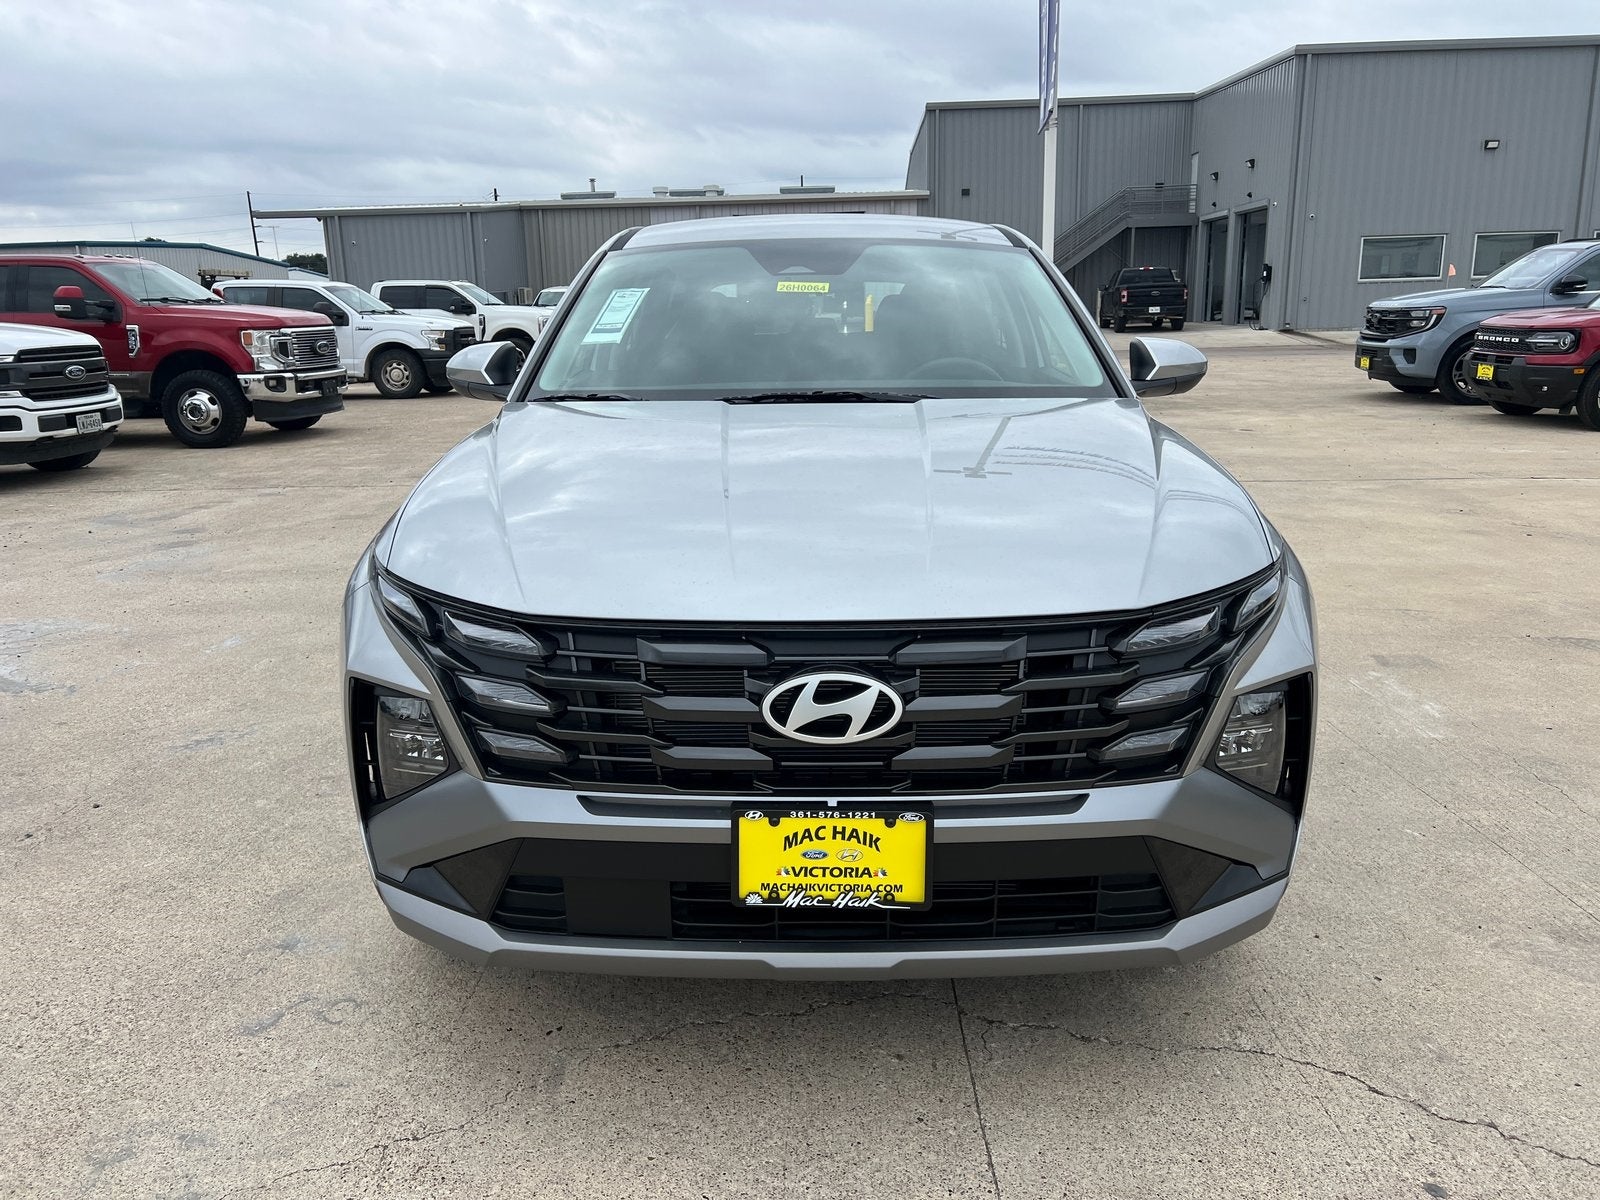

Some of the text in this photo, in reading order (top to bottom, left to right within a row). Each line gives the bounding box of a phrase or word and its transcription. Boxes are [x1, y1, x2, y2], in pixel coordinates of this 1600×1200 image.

[779, 284, 826, 292] 26H0064
[1478, 335, 1520, 343] BRONCO
[790, 811, 876, 819] 361-576-1221
[783, 825, 881, 853] MAC HAIK
[804, 850, 826, 860] Ford
[791, 866, 873, 878] VICTORIA
[760, 883, 903, 892] MACHAIKVICTORIA.COM
[783, 890, 881, 908] Mac Haik
